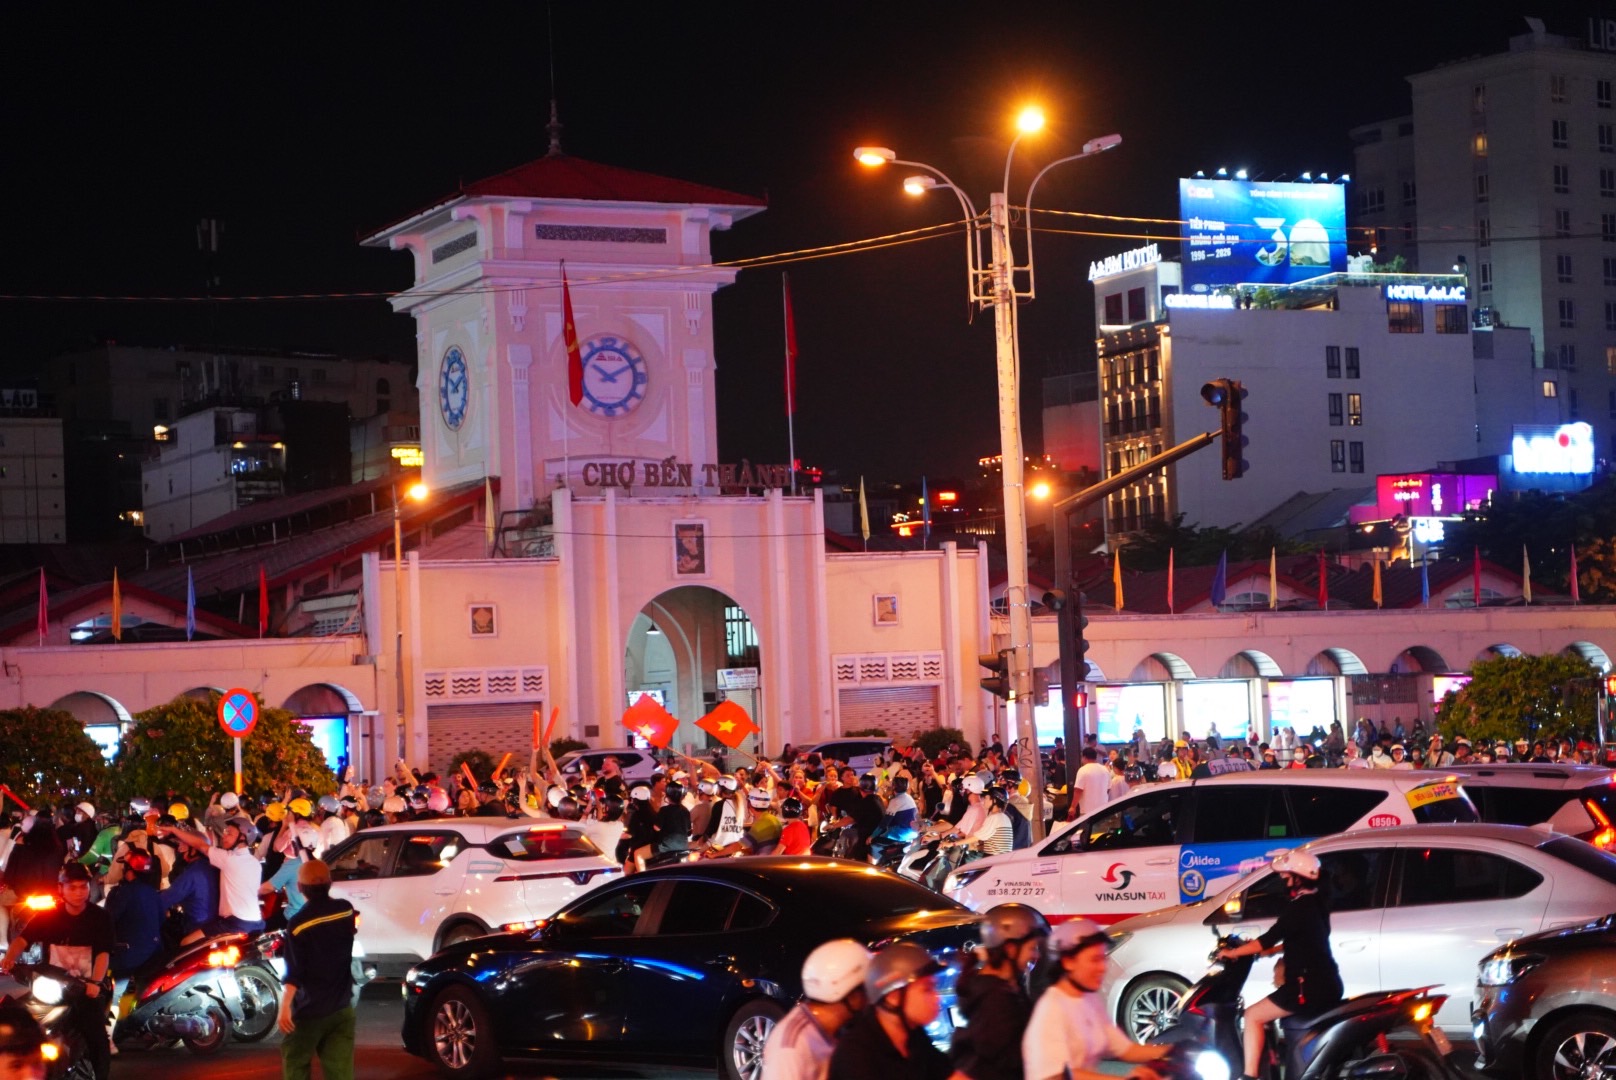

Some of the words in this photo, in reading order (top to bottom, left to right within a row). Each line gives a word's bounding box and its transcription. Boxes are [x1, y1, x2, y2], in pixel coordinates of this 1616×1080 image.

[1123, 243, 1162, 271] HOTEL
[1387, 285, 1428, 300] HOTEL
[582, 459, 636, 490] CHỢ
[643, 455, 693, 487] BẾN
[701, 458, 791, 487] THÀNH
[1371, 817, 1397, 827] 18504
[1183, 853, 1221, 867] Midea
[1023, 888, 1033, 896] 27
[1035, 888, 1045, 896] 27
[1095, 892, 1146, 901] VINASUN
[1147, 891, 1166, 900] TAXI
